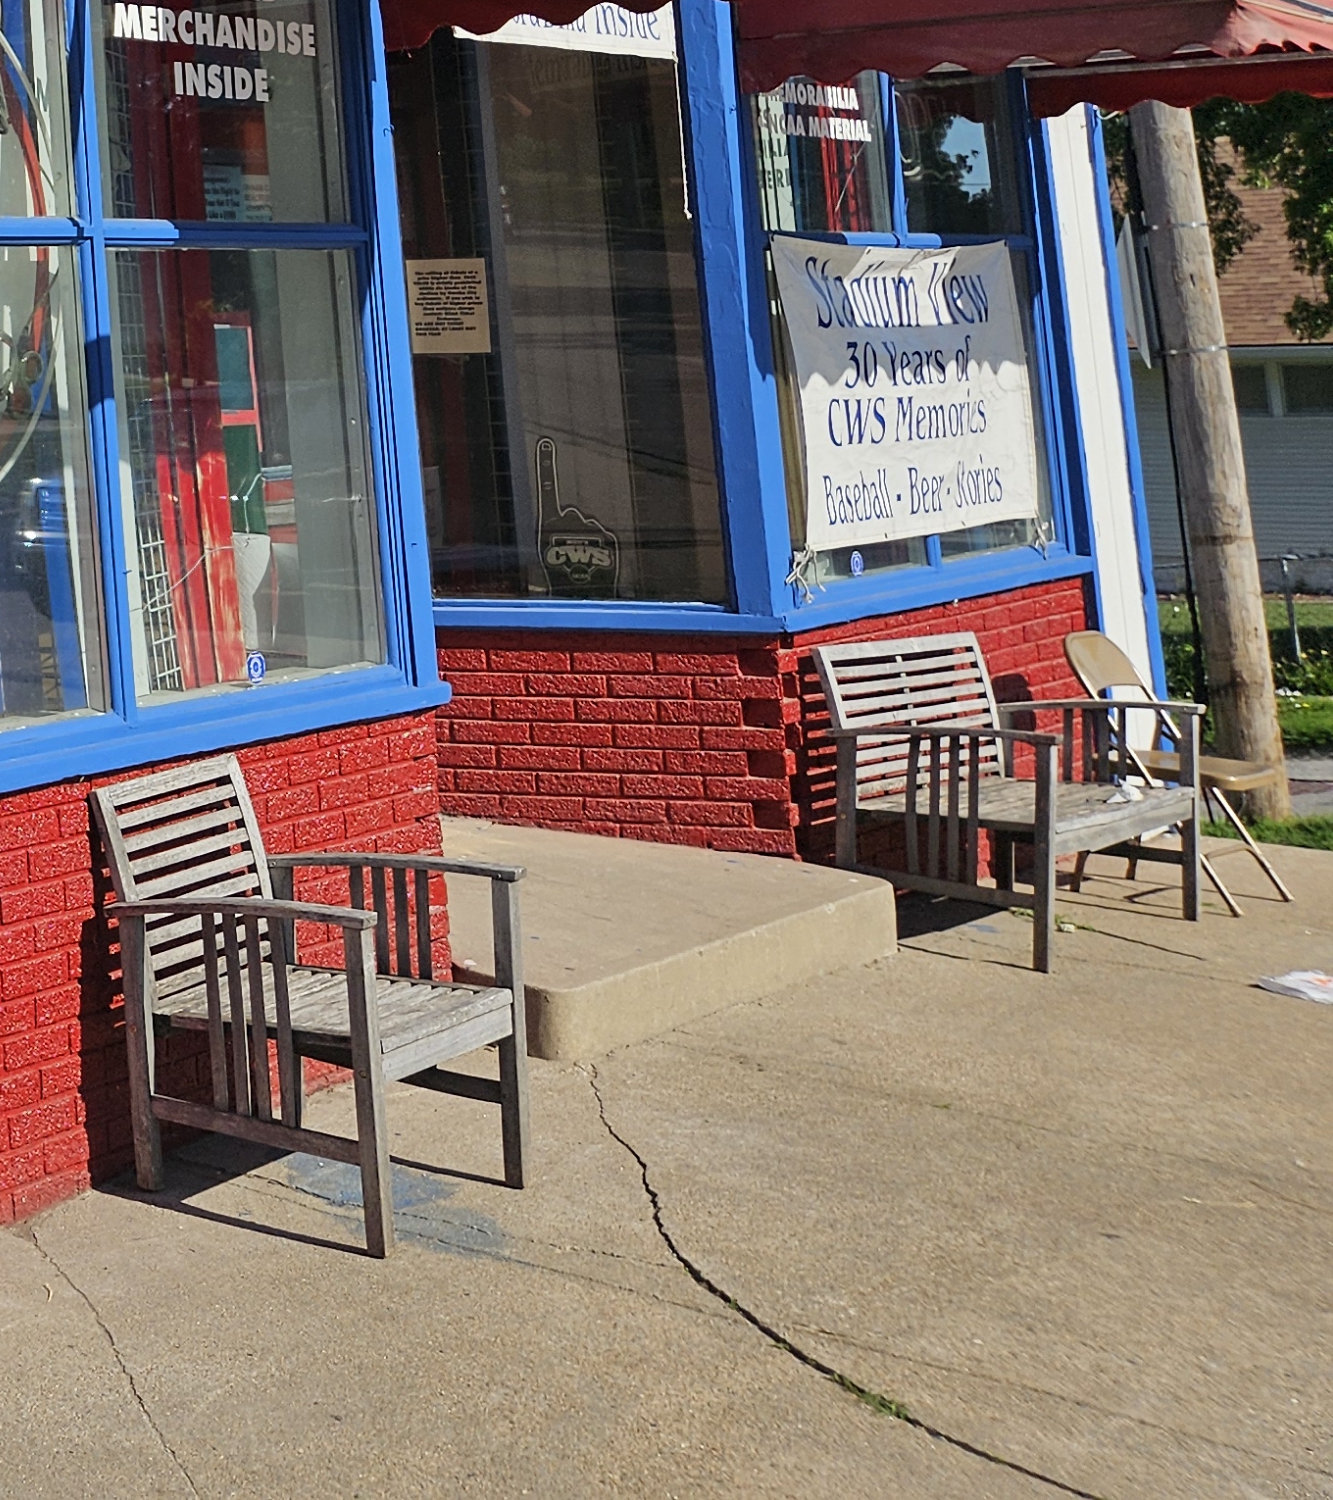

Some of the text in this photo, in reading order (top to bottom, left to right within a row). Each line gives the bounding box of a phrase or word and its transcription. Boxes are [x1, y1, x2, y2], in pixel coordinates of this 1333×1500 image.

[113, 2, 317, 57] MERCHANDISE
[173, 61, 270, 103] INSIDE
[808, 116, 873, 143] MATERIAL
[805, 256, 989, 330] Stadium View
[844, 334, 971, 389] 30 Years of
[827, 388, 987, 447] CWS Memories
[822, 468, 894, 526] Baseball
[907, 466, 945, 516] Beer
[955, 453, 1003, 509] Stories
[546, 545, 612, 567] CWS
